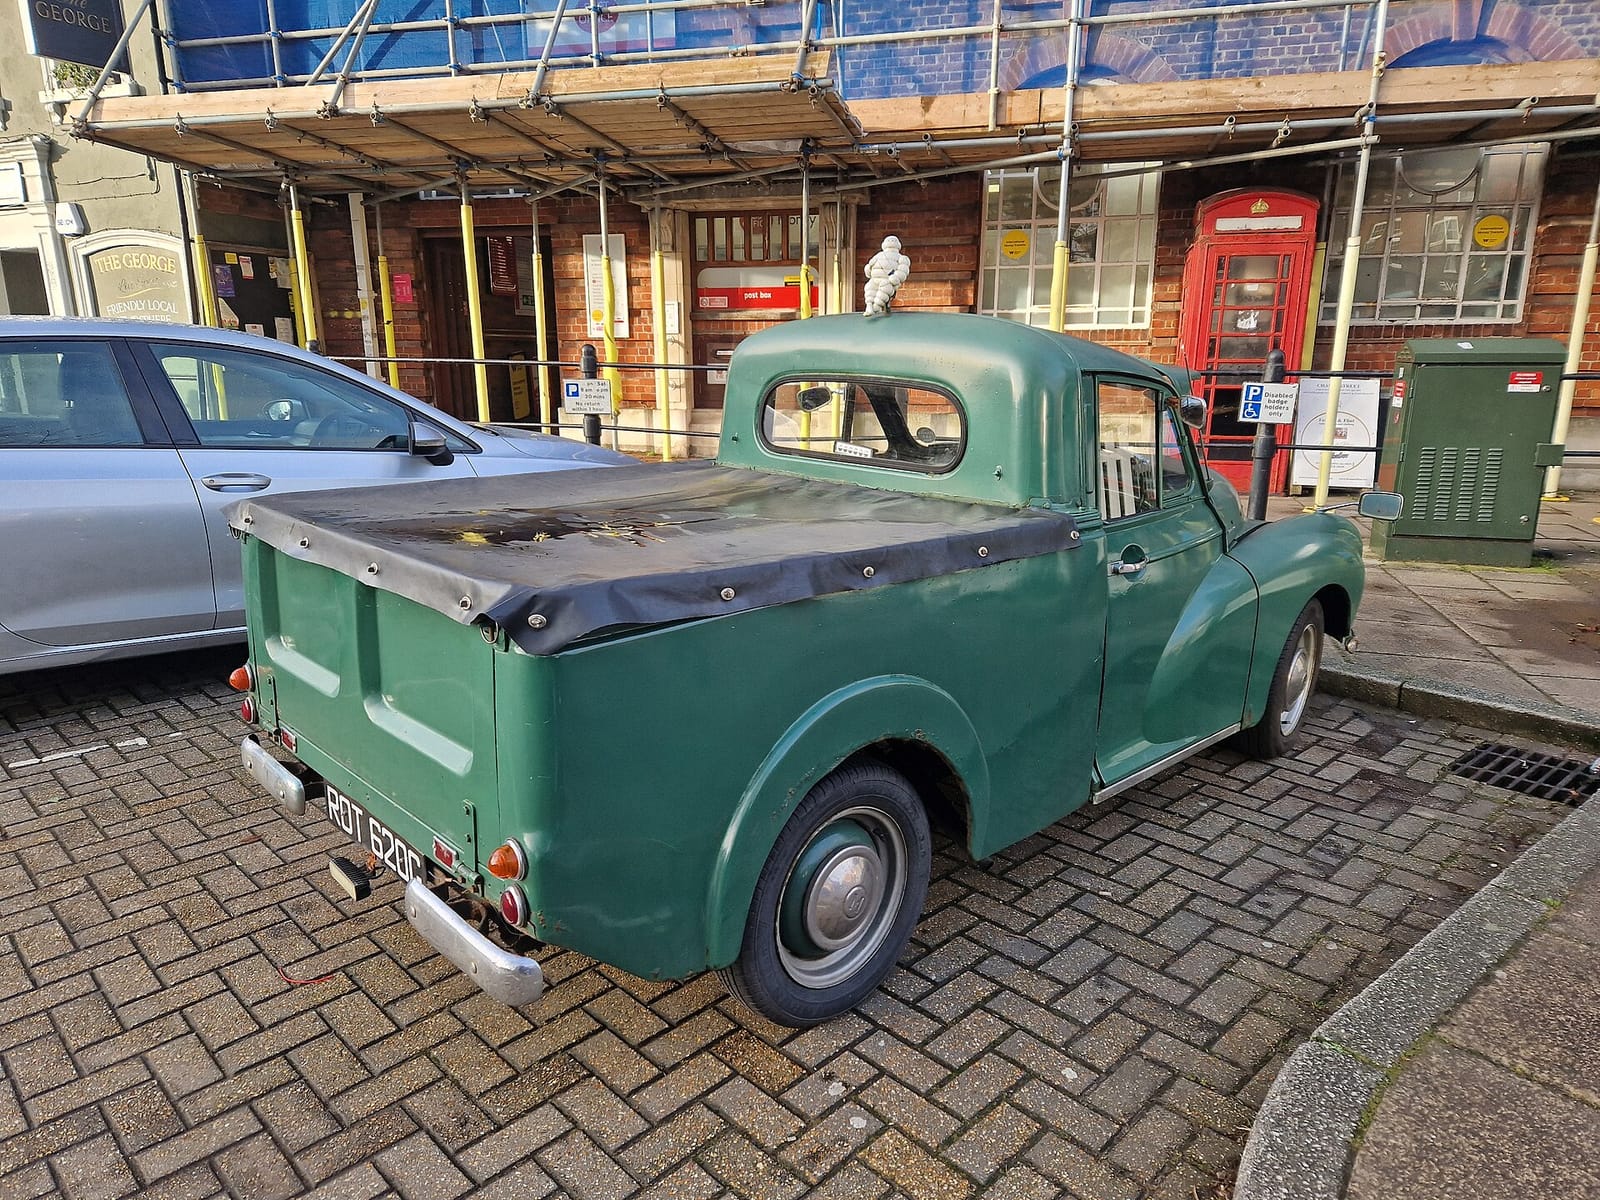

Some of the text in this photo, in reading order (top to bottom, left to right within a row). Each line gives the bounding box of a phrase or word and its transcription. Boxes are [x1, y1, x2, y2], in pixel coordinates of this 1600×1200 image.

[35, 1, 112, 34] GEORGE
[95, 252, 177, 274] THE GEORGE
[744, 291, 772, 300] post box
[105, 300, 179, 316] FRIENDLY LOCAL
[326, 784, 424, 885] ROT 620C
